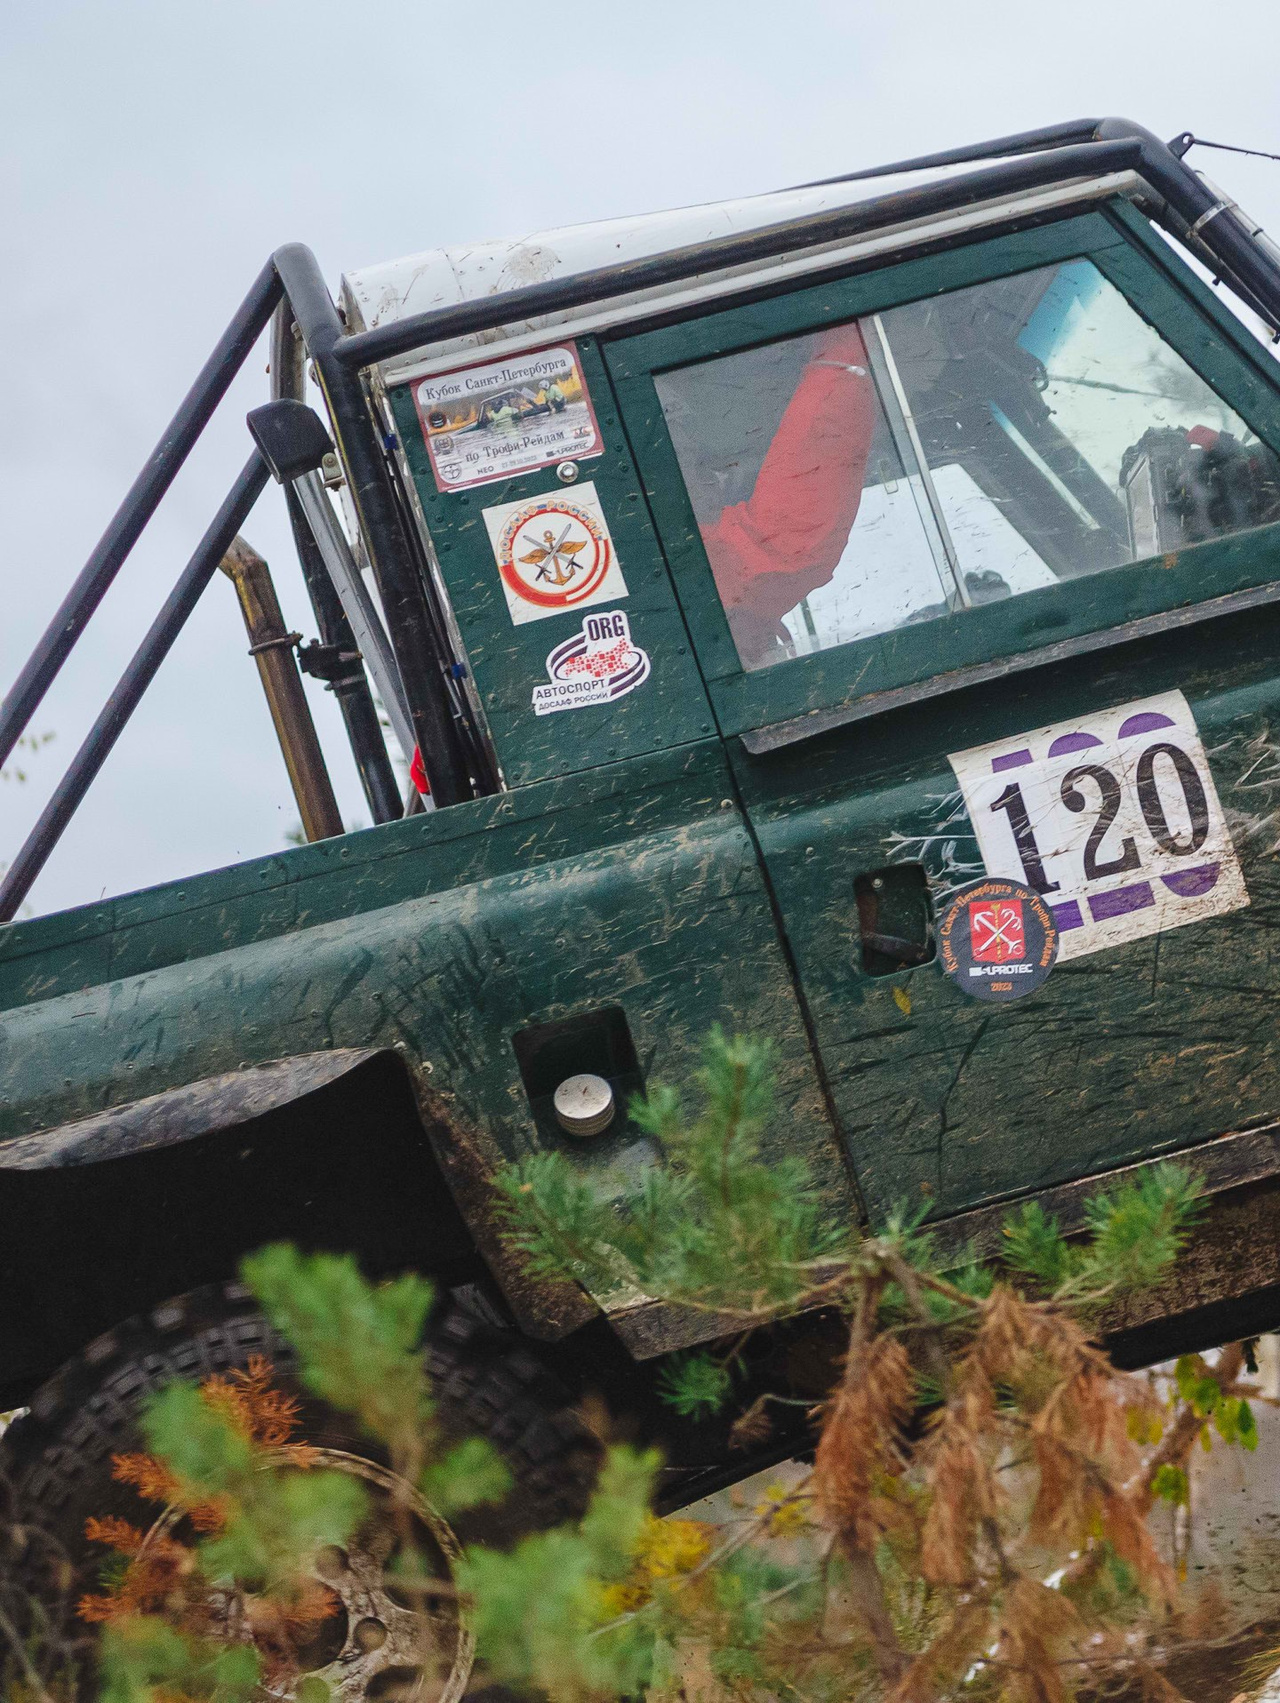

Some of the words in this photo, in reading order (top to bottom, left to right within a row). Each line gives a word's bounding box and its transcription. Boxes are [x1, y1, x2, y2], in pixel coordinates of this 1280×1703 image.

[426, 383, 461, 401] Кубок
[465, 358, 567, 391] Санкт-Петербурга
[465, 452, 480, 464] по
[483, 430, 565, 458] Трофи-Рейдам
[500, 504, 538, 563] ДОСААФ
[546, 500, 603, 539] РОССИИ
[587, 615, 625, 641] ORG
[536, 678, 605, 699] АВТОСПОРТ
[538, 697, 573, 711] ДОСААФ
[574, 692, 608, 705] РОССИИ
[990, 742, 1209, 896] 120
